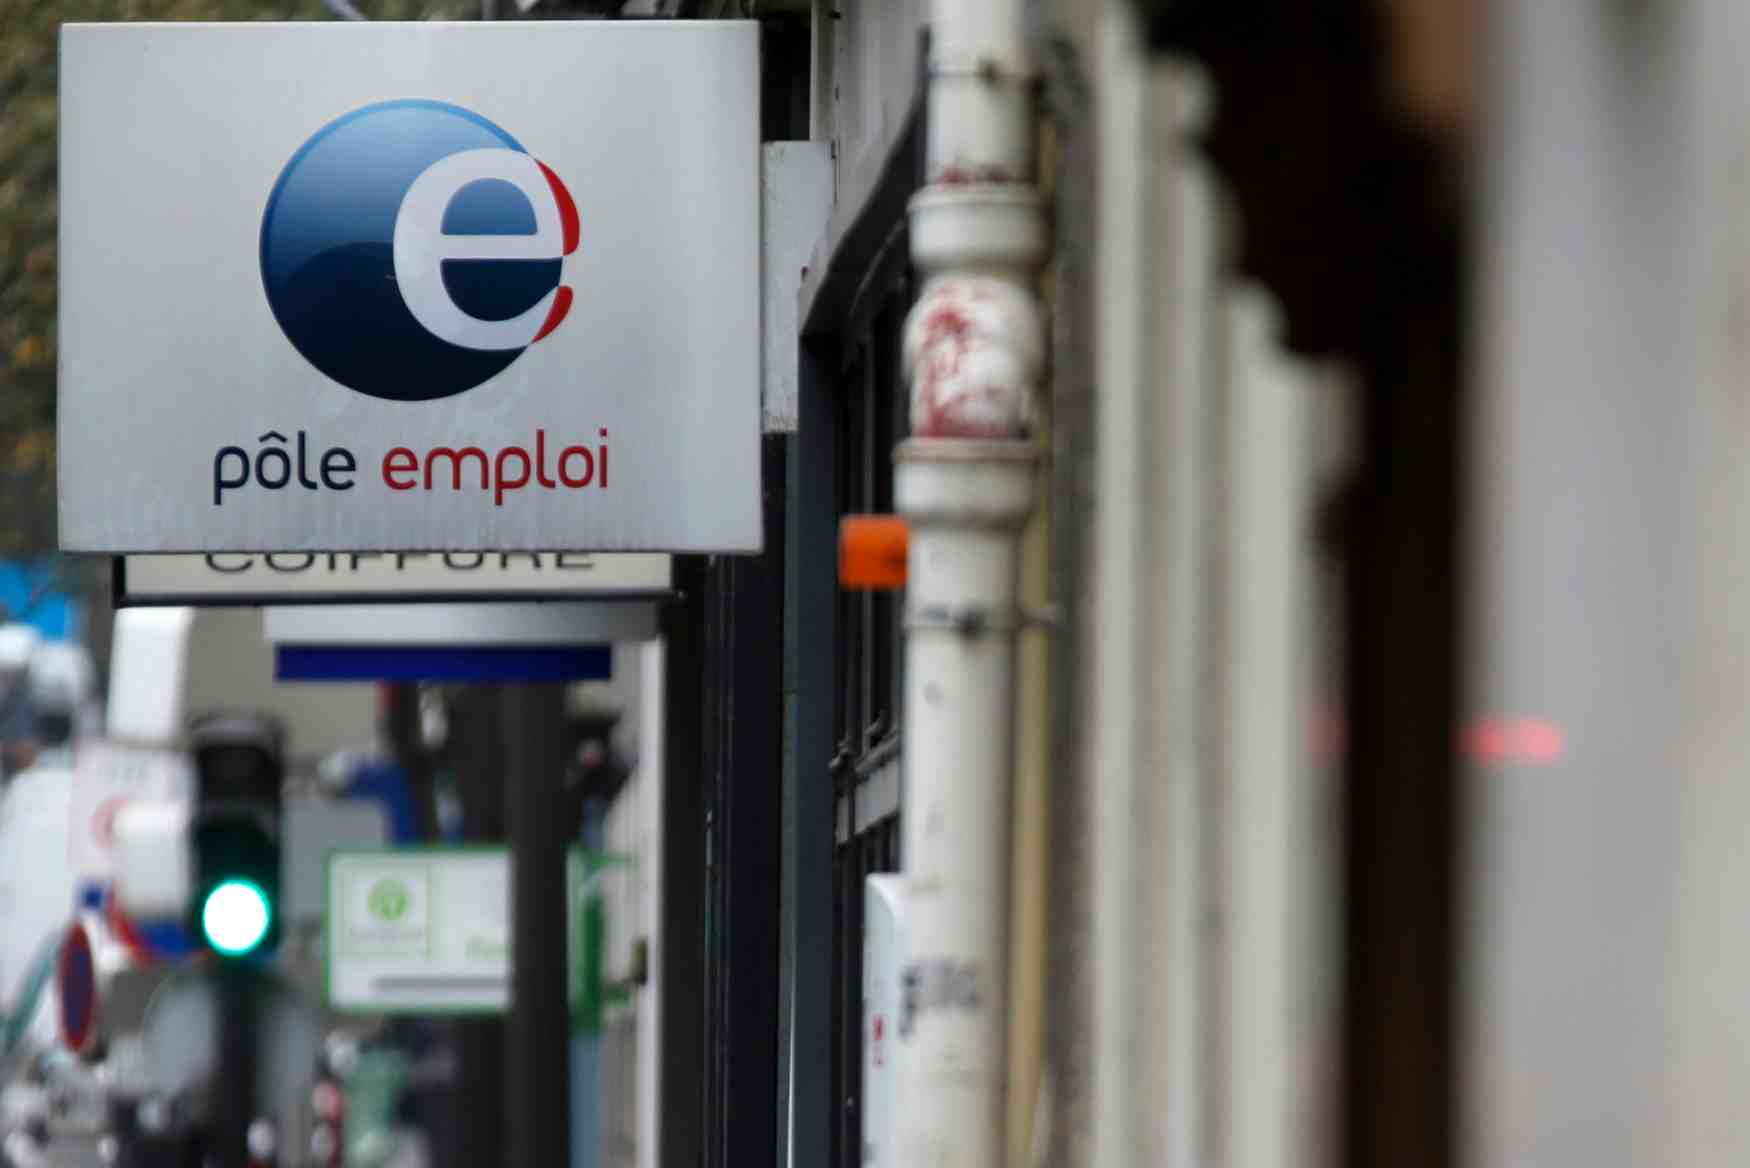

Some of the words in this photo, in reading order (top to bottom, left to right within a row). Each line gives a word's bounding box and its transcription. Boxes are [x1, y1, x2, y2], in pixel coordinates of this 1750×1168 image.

[393, 148, 580, 351] e
[213, 430, 356, 505] pôle
[382, 428, 608, 505] emploi
